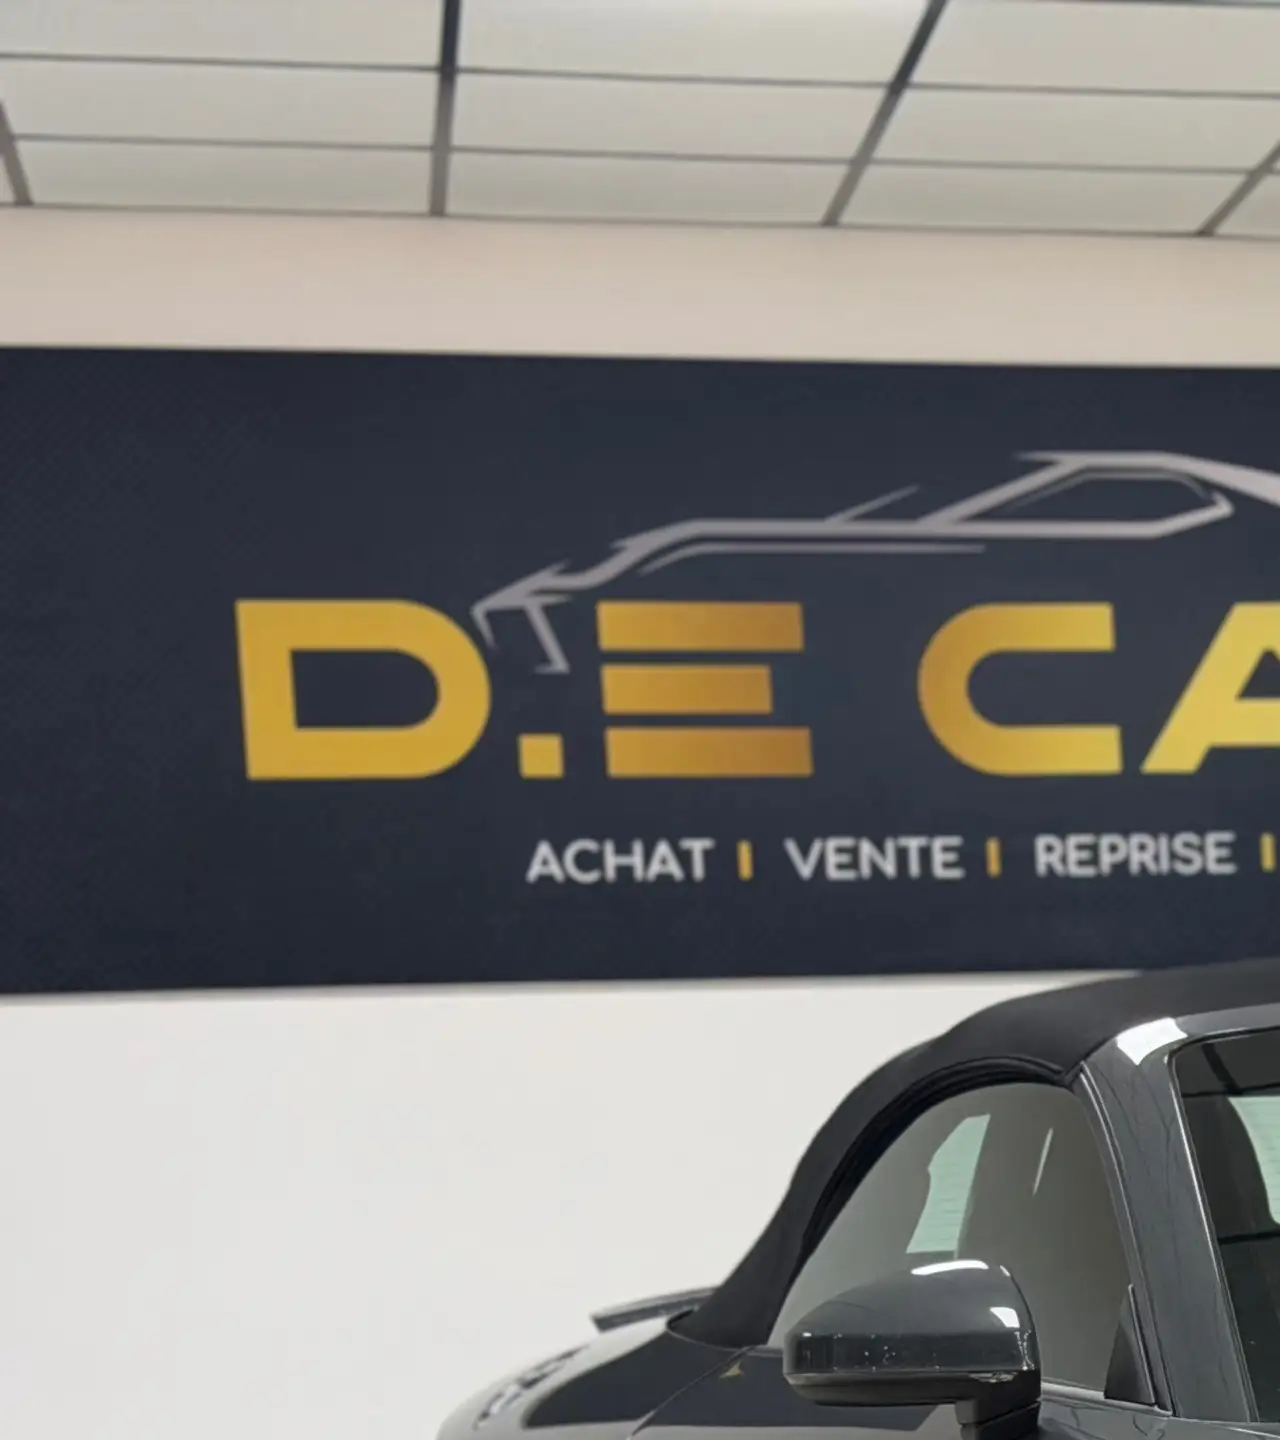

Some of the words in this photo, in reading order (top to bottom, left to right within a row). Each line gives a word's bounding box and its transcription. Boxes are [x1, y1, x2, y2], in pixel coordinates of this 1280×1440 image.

[234, 599, 814, 782] D.E
[525, 836, 715, 885] ACHAT
[783, 834, 965, 882] VENTE
[1033, 830, 1238, 878] REPRISE
